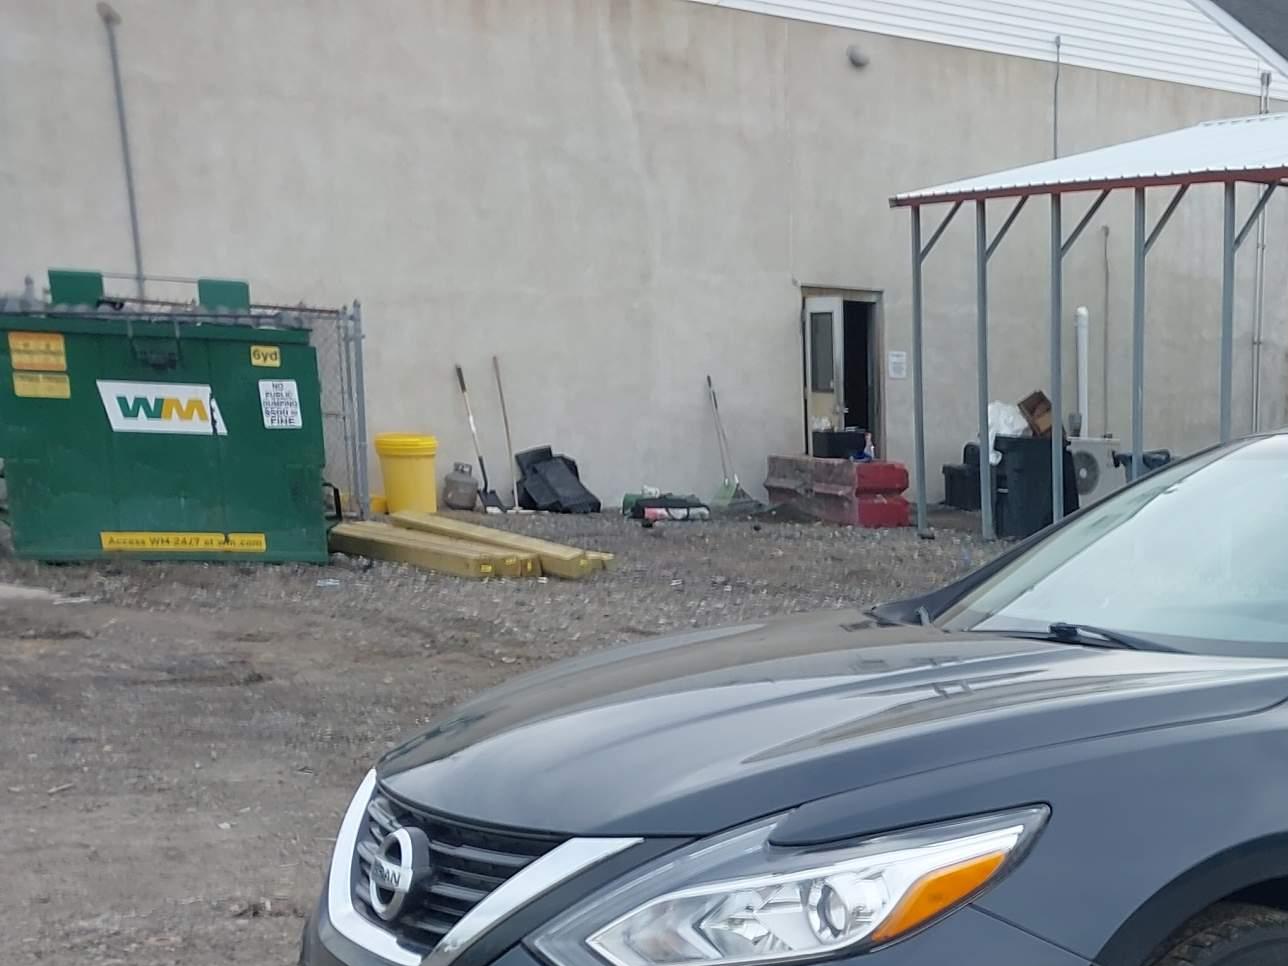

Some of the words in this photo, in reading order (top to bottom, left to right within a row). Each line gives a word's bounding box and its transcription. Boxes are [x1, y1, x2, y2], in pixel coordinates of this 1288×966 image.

[271, 383, 284, 391] NO
[116, 396, 209, 421] WM
[271, 416, 296, 425] FINE
